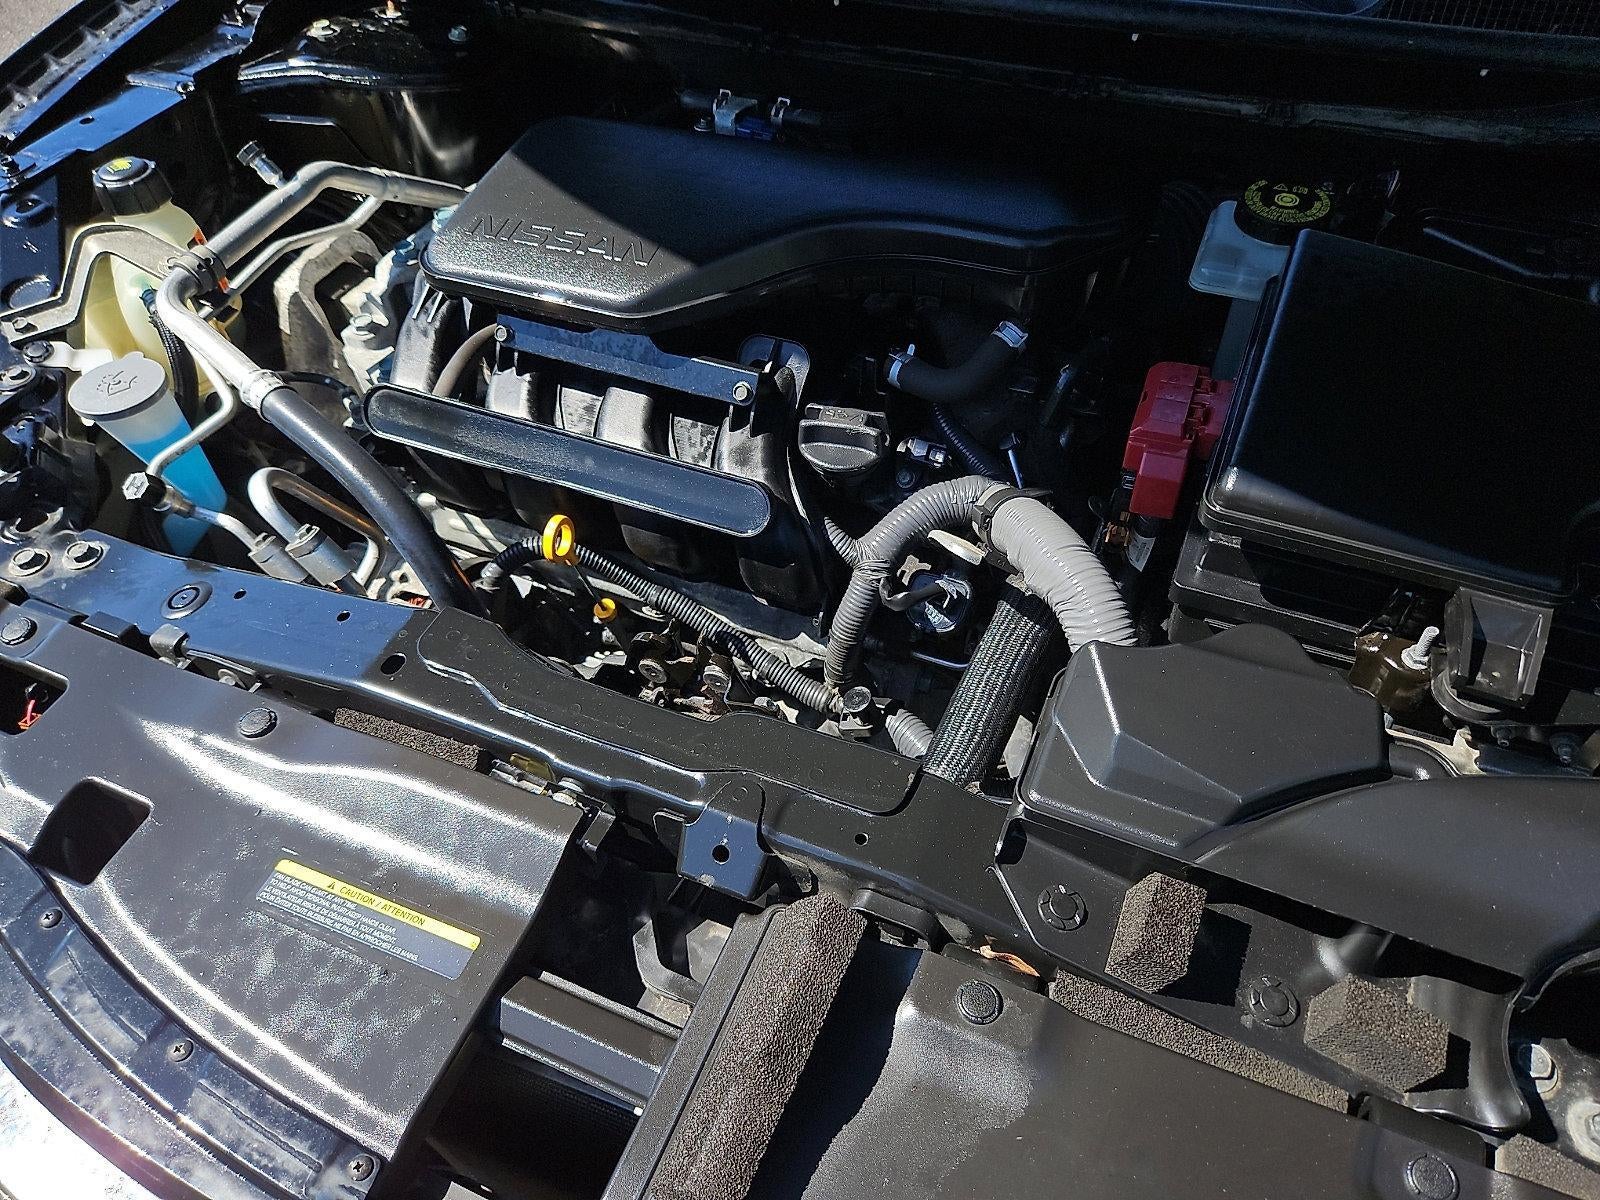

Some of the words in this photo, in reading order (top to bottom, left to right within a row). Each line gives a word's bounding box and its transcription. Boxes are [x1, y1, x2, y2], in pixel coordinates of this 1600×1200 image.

[465, 215, 660, 268] NISSAN
[339, 886, 376, 906] CAUTION
[380, 903, 426, 926] ATTENTION
